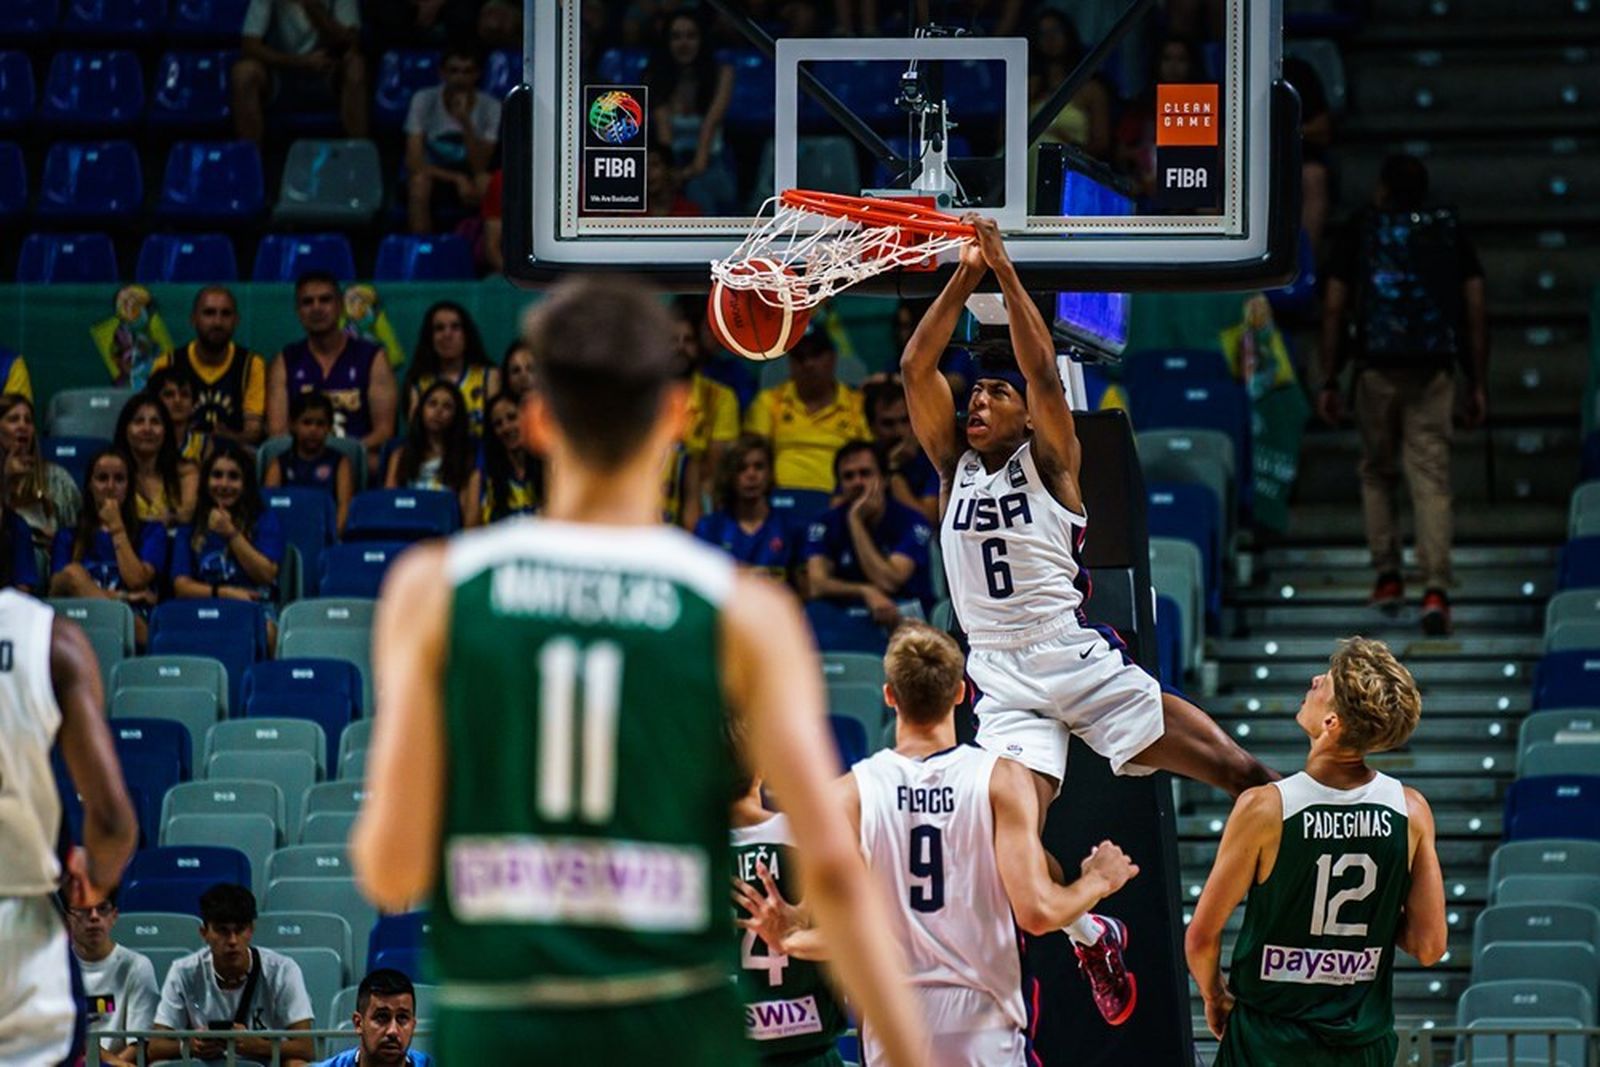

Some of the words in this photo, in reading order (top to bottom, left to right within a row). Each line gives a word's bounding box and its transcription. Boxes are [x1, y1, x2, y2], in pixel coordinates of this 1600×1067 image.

[1164, 103, 1211, 113] CLEAN
[1164, 117, 1211, 127] GAME
[594, 157, 636, 178] FIBA
[1166, 167, 1207, 188] FIBA
[953, 492, 1033, 532] USA
[981, 537, 1014, 599] 6
[538, 634, 622, 824] 11
[897, 786, 955, 814] FLAGG
[1303, 810, 1393, 839] PADEGIMAS
[910, 824, 945, 913] 9
[1310, 853, 1378, 936] 12
[738, 922, 790, 987] 4
